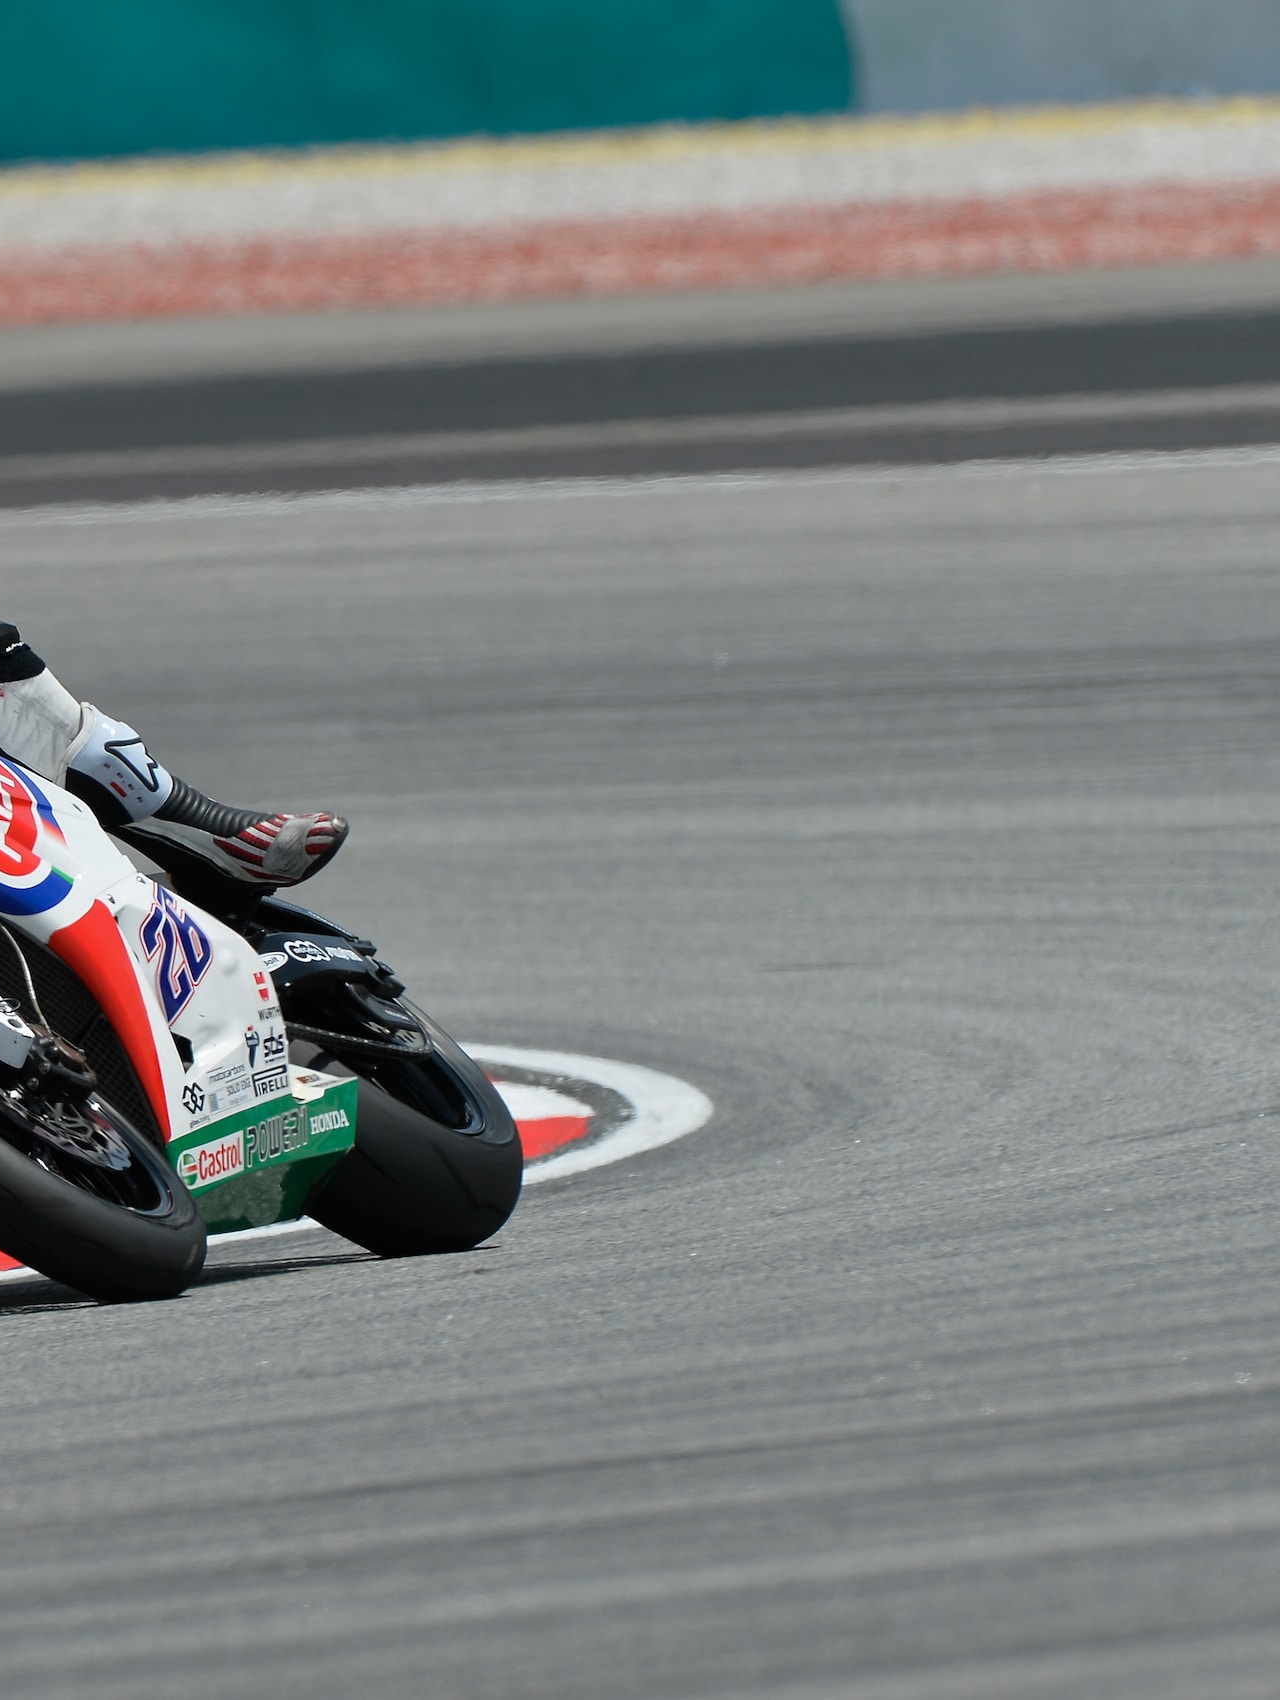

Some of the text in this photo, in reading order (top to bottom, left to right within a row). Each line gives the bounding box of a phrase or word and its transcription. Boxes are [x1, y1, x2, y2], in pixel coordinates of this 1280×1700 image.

[139, 881, 214, 1027] 26
[252, 1064, 289, 1097] PIRELLI
[198, 1140, 243, 1181] Castrol
[310, 1109, 350, 1135] HONDA
